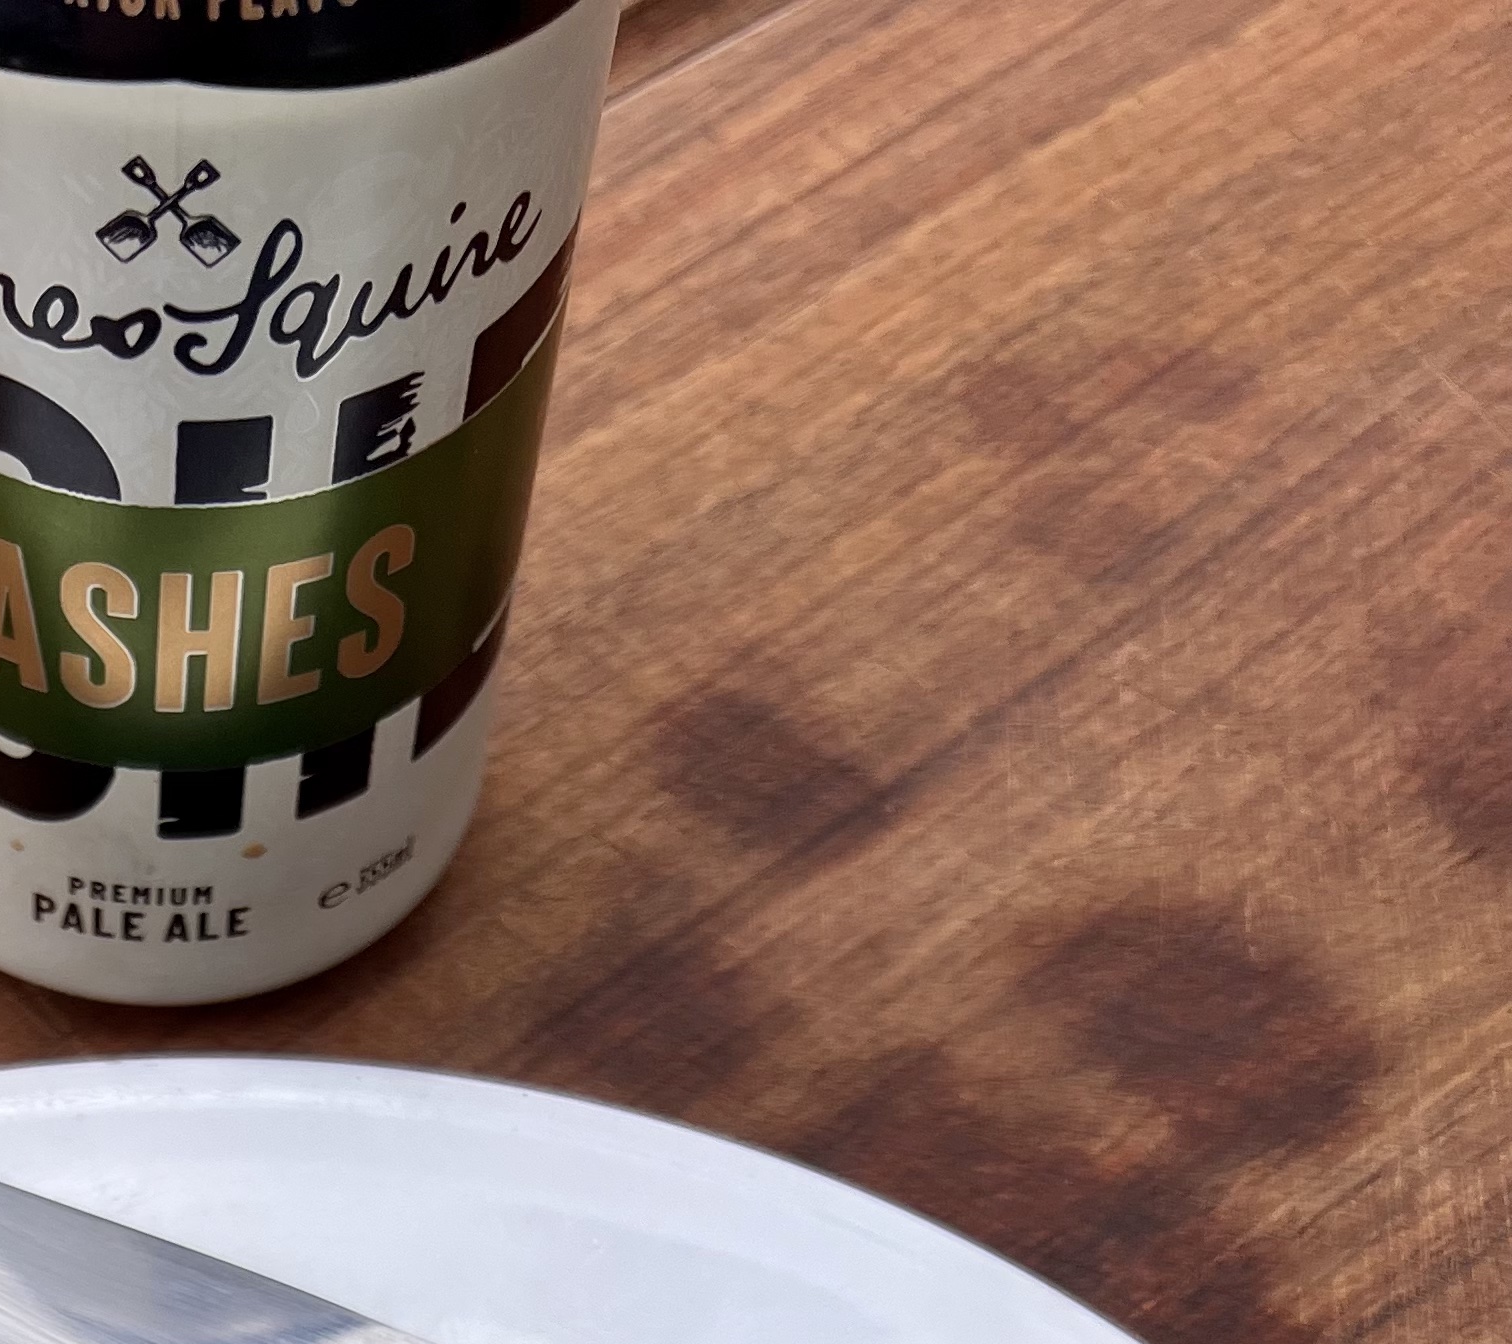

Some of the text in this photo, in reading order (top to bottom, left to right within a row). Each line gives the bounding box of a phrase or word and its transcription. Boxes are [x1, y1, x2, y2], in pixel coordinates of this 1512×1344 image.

[163, 188, 542, 378] Squire
[32, 891, 252, 943] PALE ALE
[67, 875, 214, 907] PREMIUM
